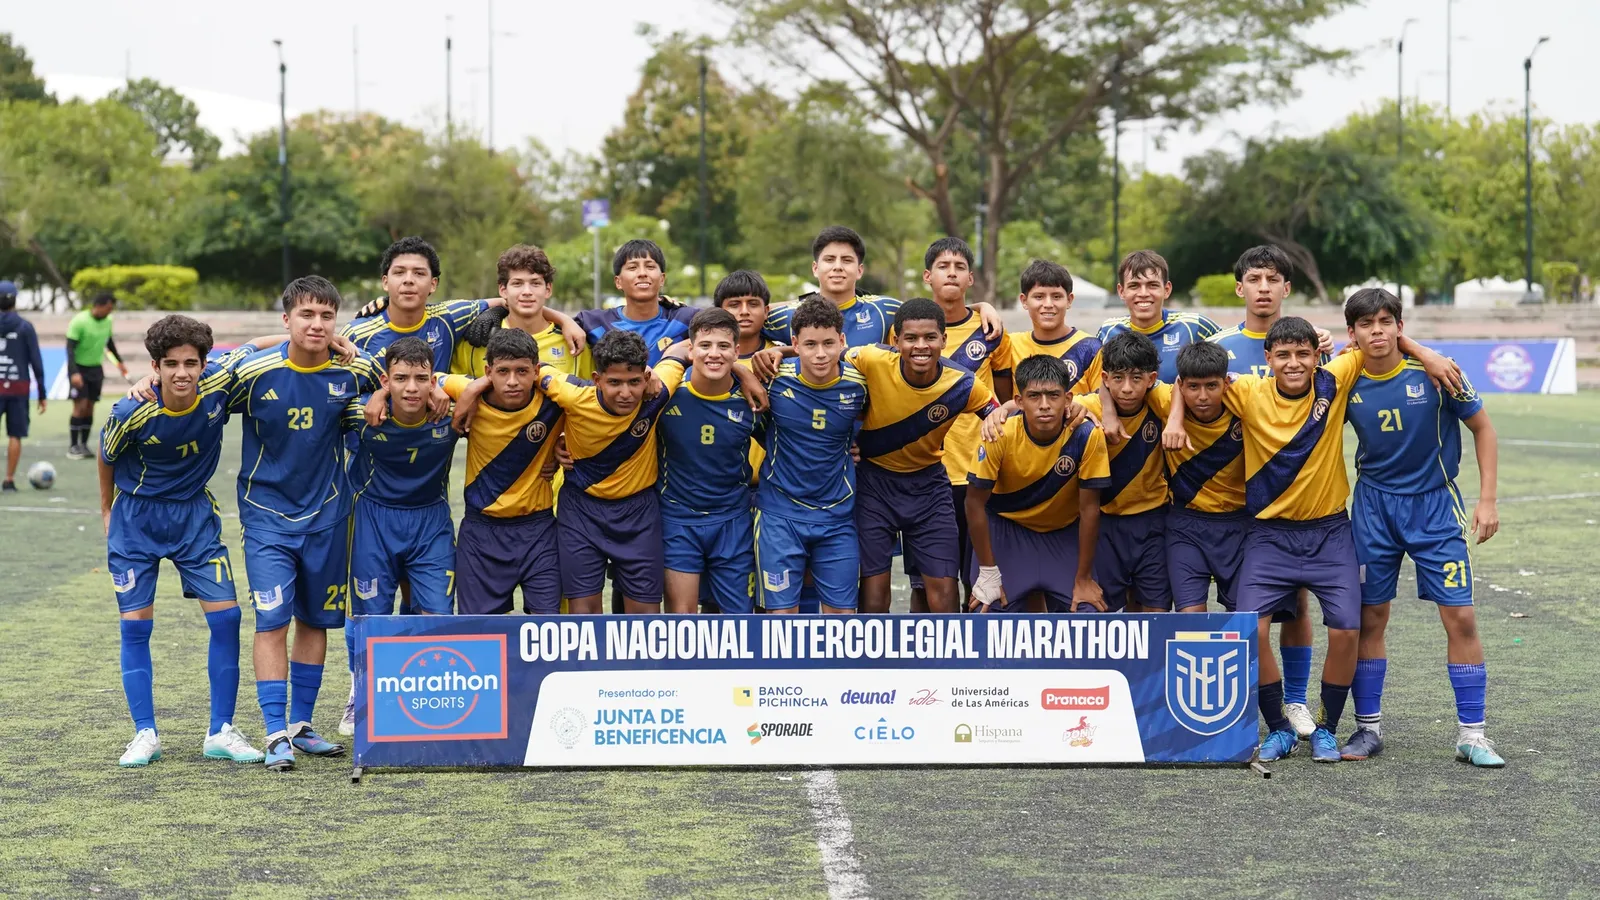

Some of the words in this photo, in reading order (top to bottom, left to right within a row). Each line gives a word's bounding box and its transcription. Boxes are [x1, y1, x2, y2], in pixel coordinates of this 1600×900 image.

[287, 407, 313, 430] 23
[812, 409, 826, 430] 5
[1377, 408, 1403, 432] 21
[701, 424, 715, 445] 8
[176, 440, 199, 458] 71
[406, 448, 418, 464] 7
[208, 556, 232, 583] 71
[1443, 560, 1467, 588] 21
[446, 570, 455, 596] 7
[323, 584, 347, 611] 23
[519, 621, 599, 662] COPA
[606, 620, 754, 661] NACIONAL
[762, 619, 978, 660] INTERCOLEGIAL
[987, 619, 1149, 660] MARATHON
[376, 671, 499, 693] marathon
[598, 689, 655, 698] Presentado
[658, 690, 678, 700] por:
[759, 687, 803, 696] BANCO
[840, 689, 896, 705] deuna!
[951, 687, 1009, 696] Universidad
[1046, 693, 1105, 706] Pronaca
[411, 696, 465, 710] SPORTS
[759, 698, 828, 707] PICHINCHA
[951, 699, 963, 707] de
[966, 699, 982, 707] Las
[985, 698, 1029, 707] Américas
[593, 708, 656, 725] JUNTA
[661, 708, 684, 724] DE
[594, 728, 727, 745] BENEFICENCIA
[760, 722, 813, 737] SPORADE
[975, 724, 1023, 739] Hispana
